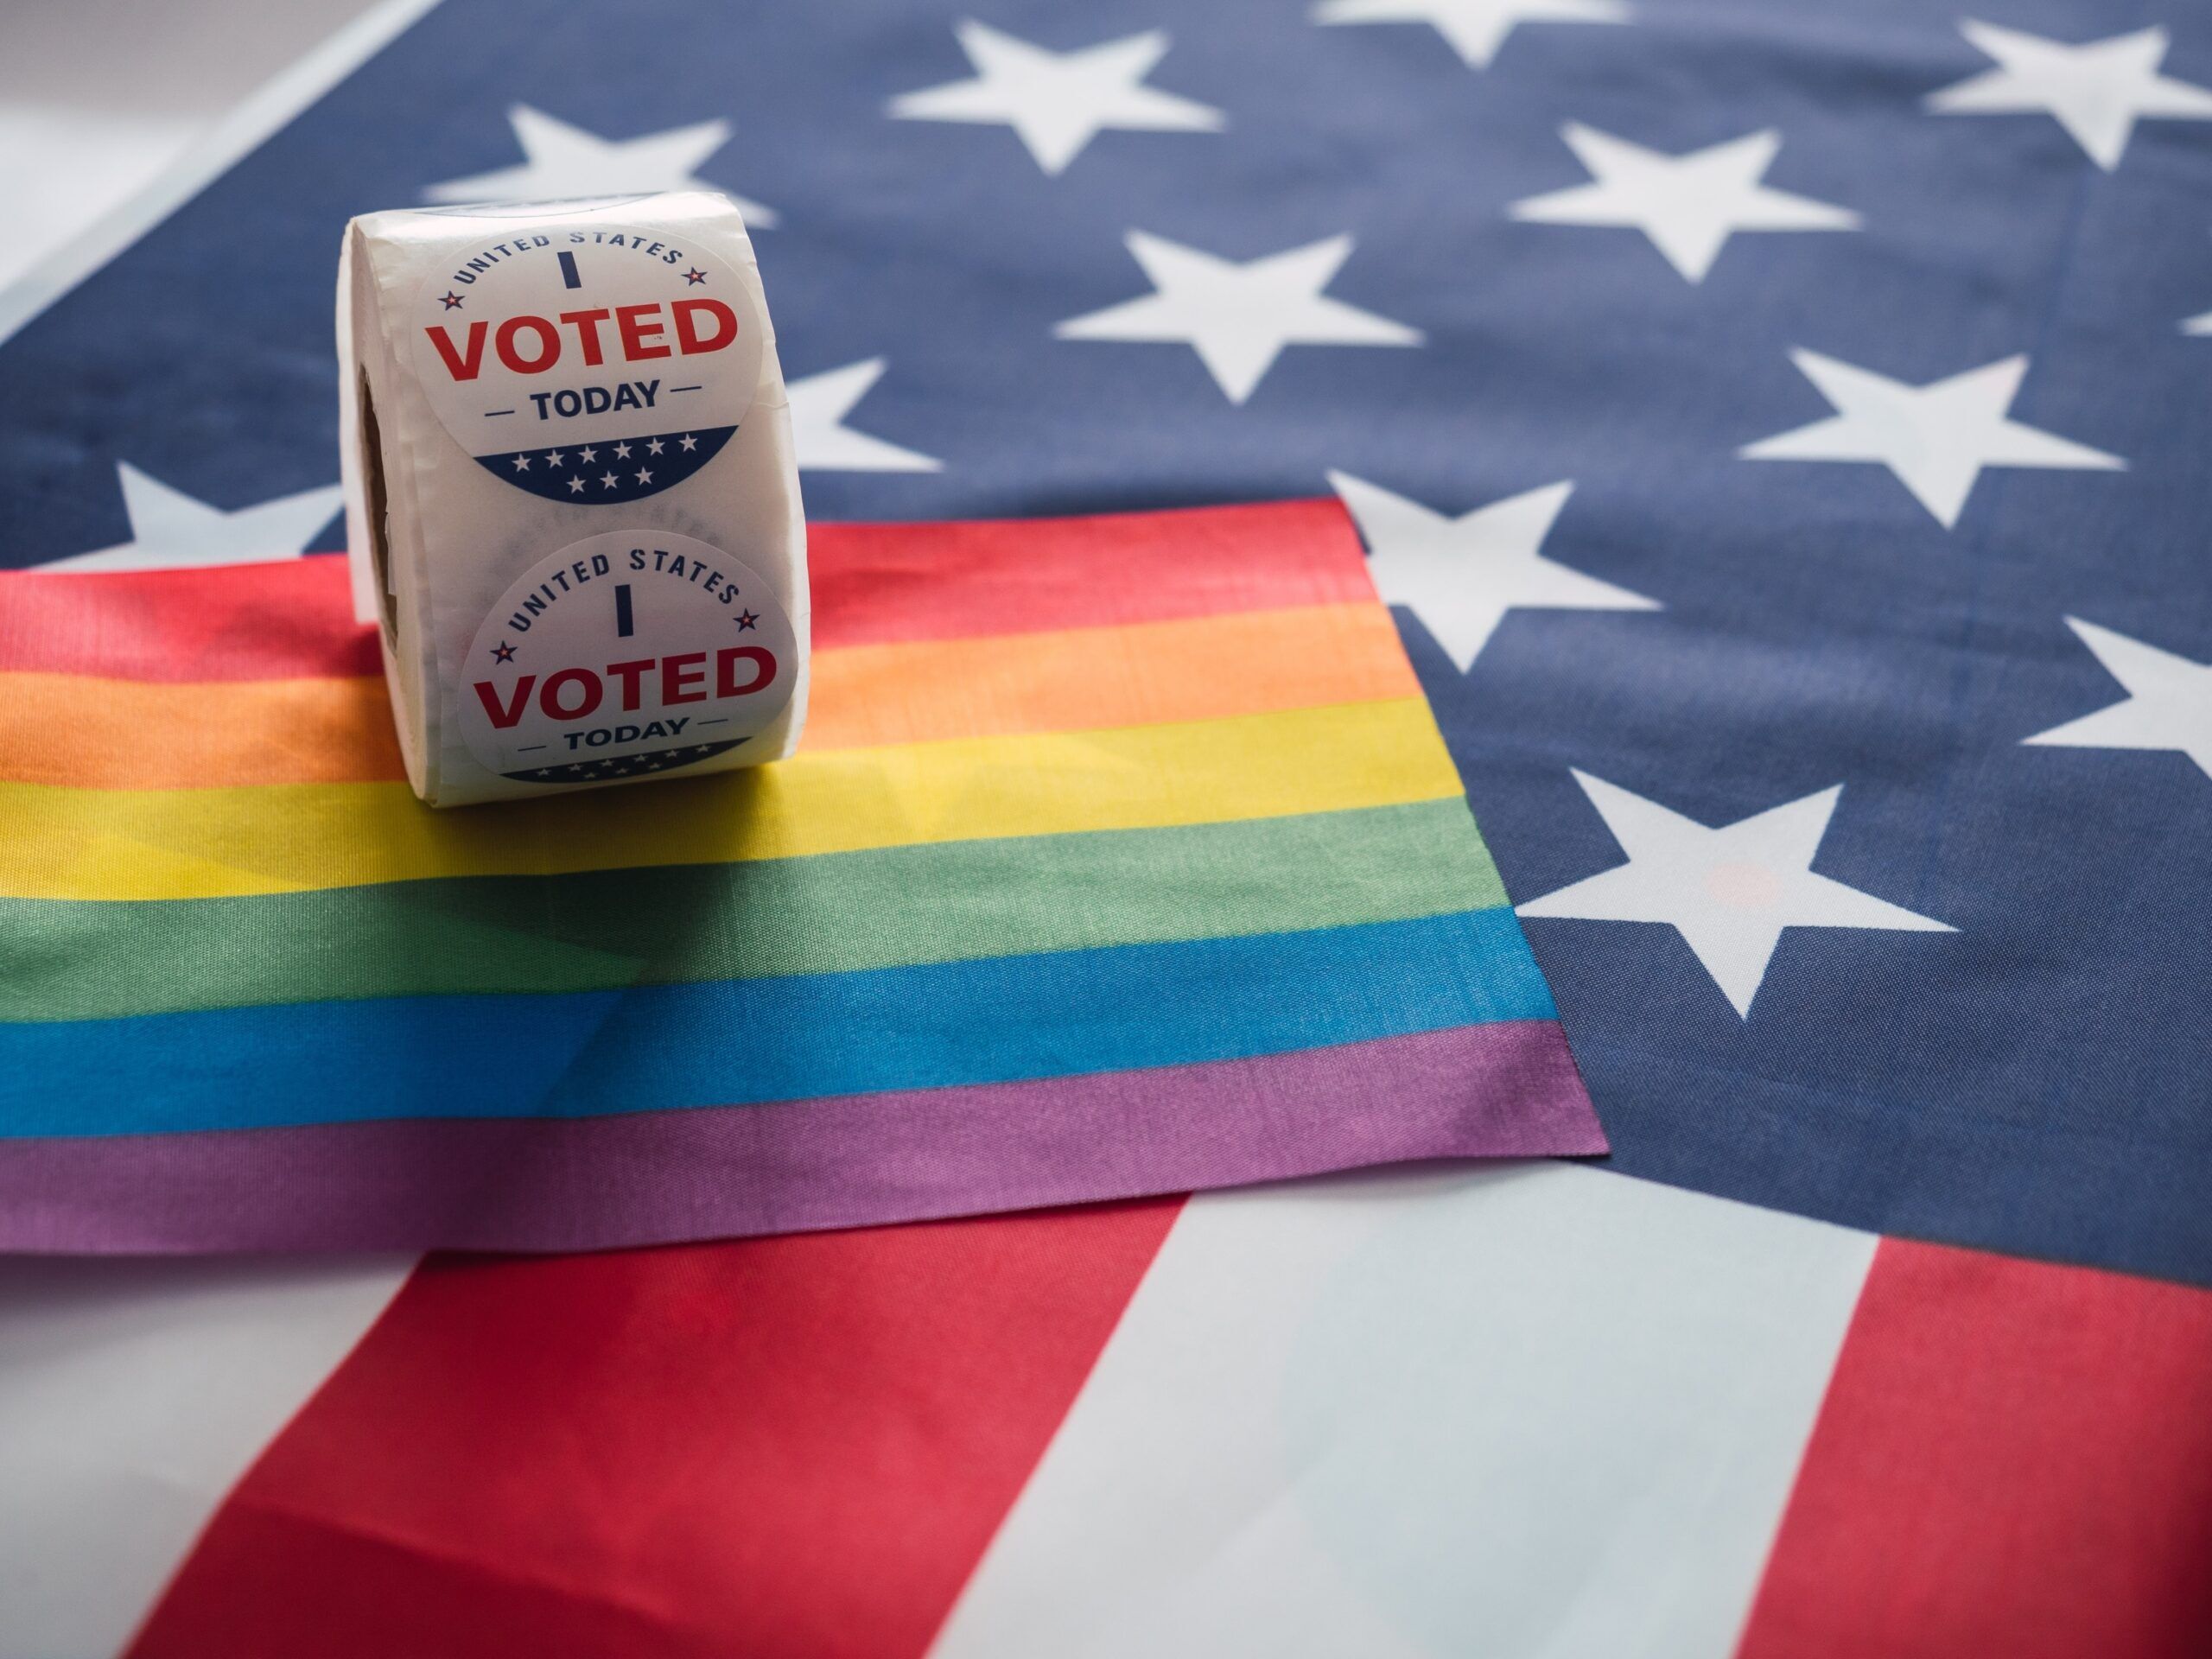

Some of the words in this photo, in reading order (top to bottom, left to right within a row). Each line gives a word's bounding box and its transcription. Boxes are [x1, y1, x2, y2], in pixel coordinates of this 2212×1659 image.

[454, 234, 550, 285] UNITED
[569, 232, 683, 265] STATES
[556, 251, 582, 289] I
[424, 298, 738, 382] VOTED
[530, 379, 661, 420] TODAY
[508, 554, 610, 632] UNITED
[629, 549, 741, 605] STATES
[614, 584, 634, 638] I
[473, 645, 778, 728] VOTED
[563, 717, 690, 750] TODAY
